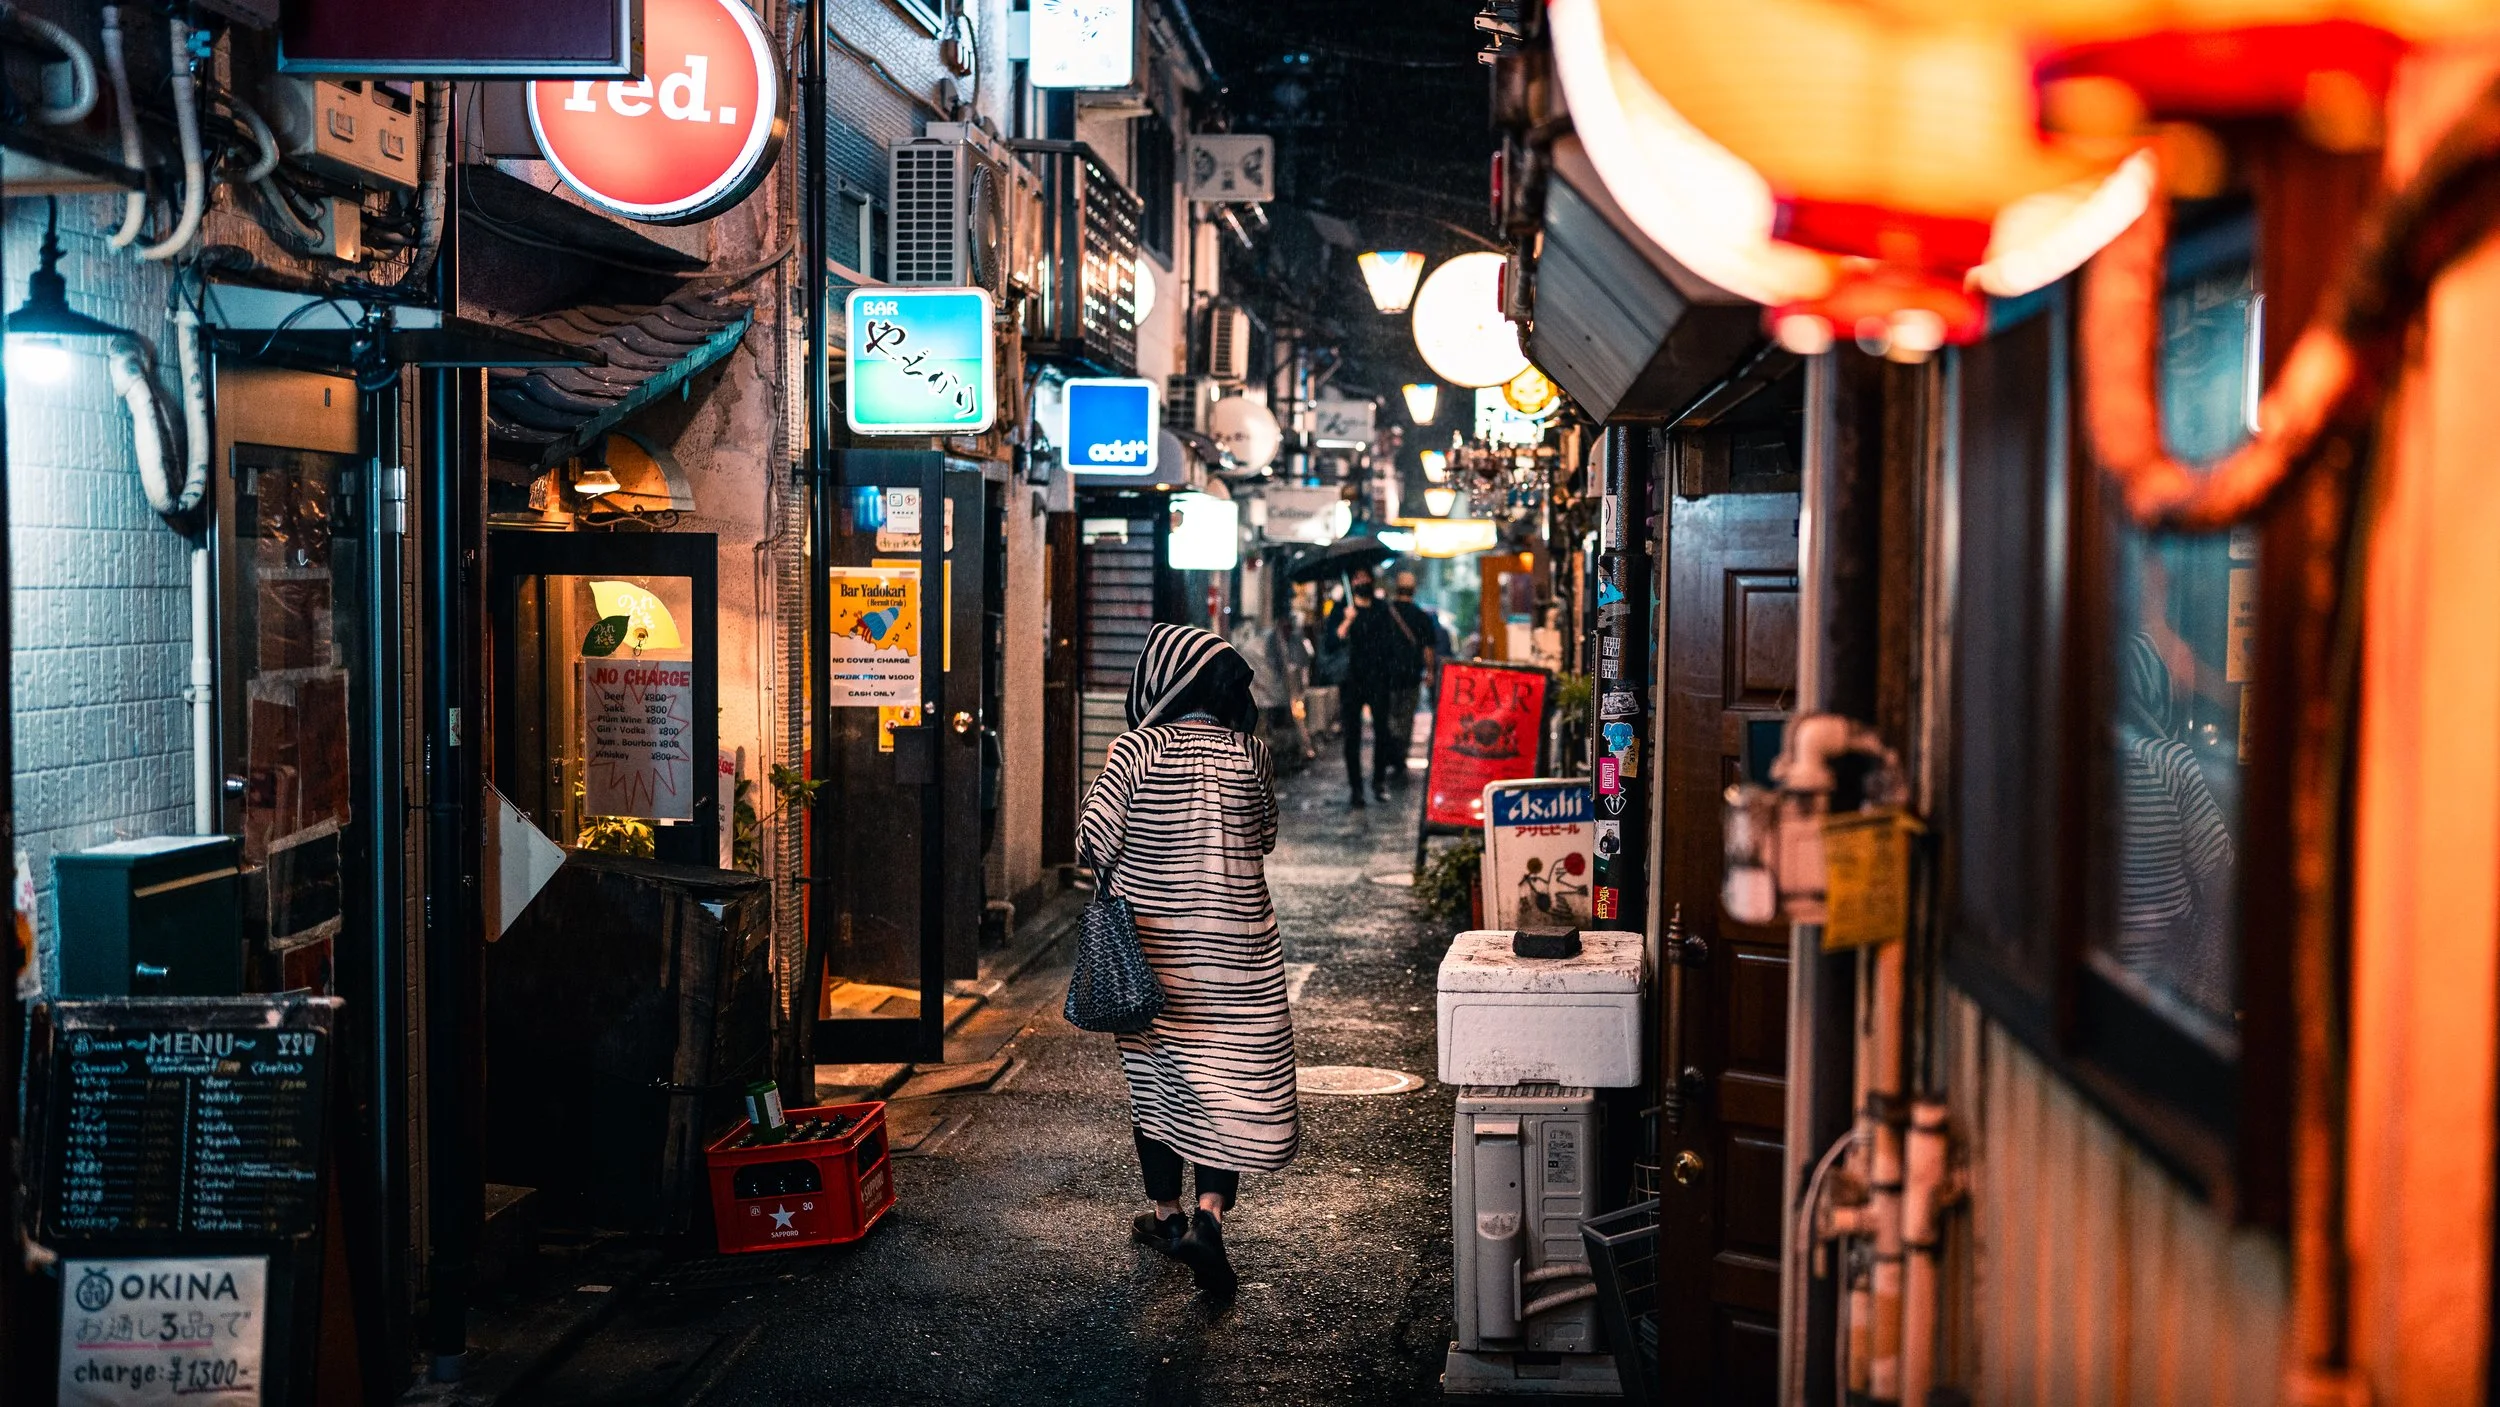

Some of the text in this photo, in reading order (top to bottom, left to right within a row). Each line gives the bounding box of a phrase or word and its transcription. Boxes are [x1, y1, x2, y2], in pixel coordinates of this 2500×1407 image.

[564, 54, 737, 125] red.
[863, 300, 899, 316] BAR
[865, 320, 975, 416] やどかり
[840, 584, 906, 598] Bar Yadokari
[596, 667, 691, 688] NO CHARGE
[604, 691, 667, 702] Beer ¥800
[1452, 676, 1534, 714] BAR
[604, 704, 667, 714] Sake ¥800
[597, 715, 667, 725] Plum Wine ¥800
[596, 725, 679, 736] Gin Vodka ¥800
[622, 738, 657, 748] Bourbon
[595, 750, 630, 761] Whiskey
[1504, 787, 1583, 821] Asahi
[1515, 824, 1581, 838] アサヒビール
[802, 1201, 814, 1211] 30
[771, 1230, 799, 1239] SAPPORO
[121, 1271, 240, 1301] OKINA
